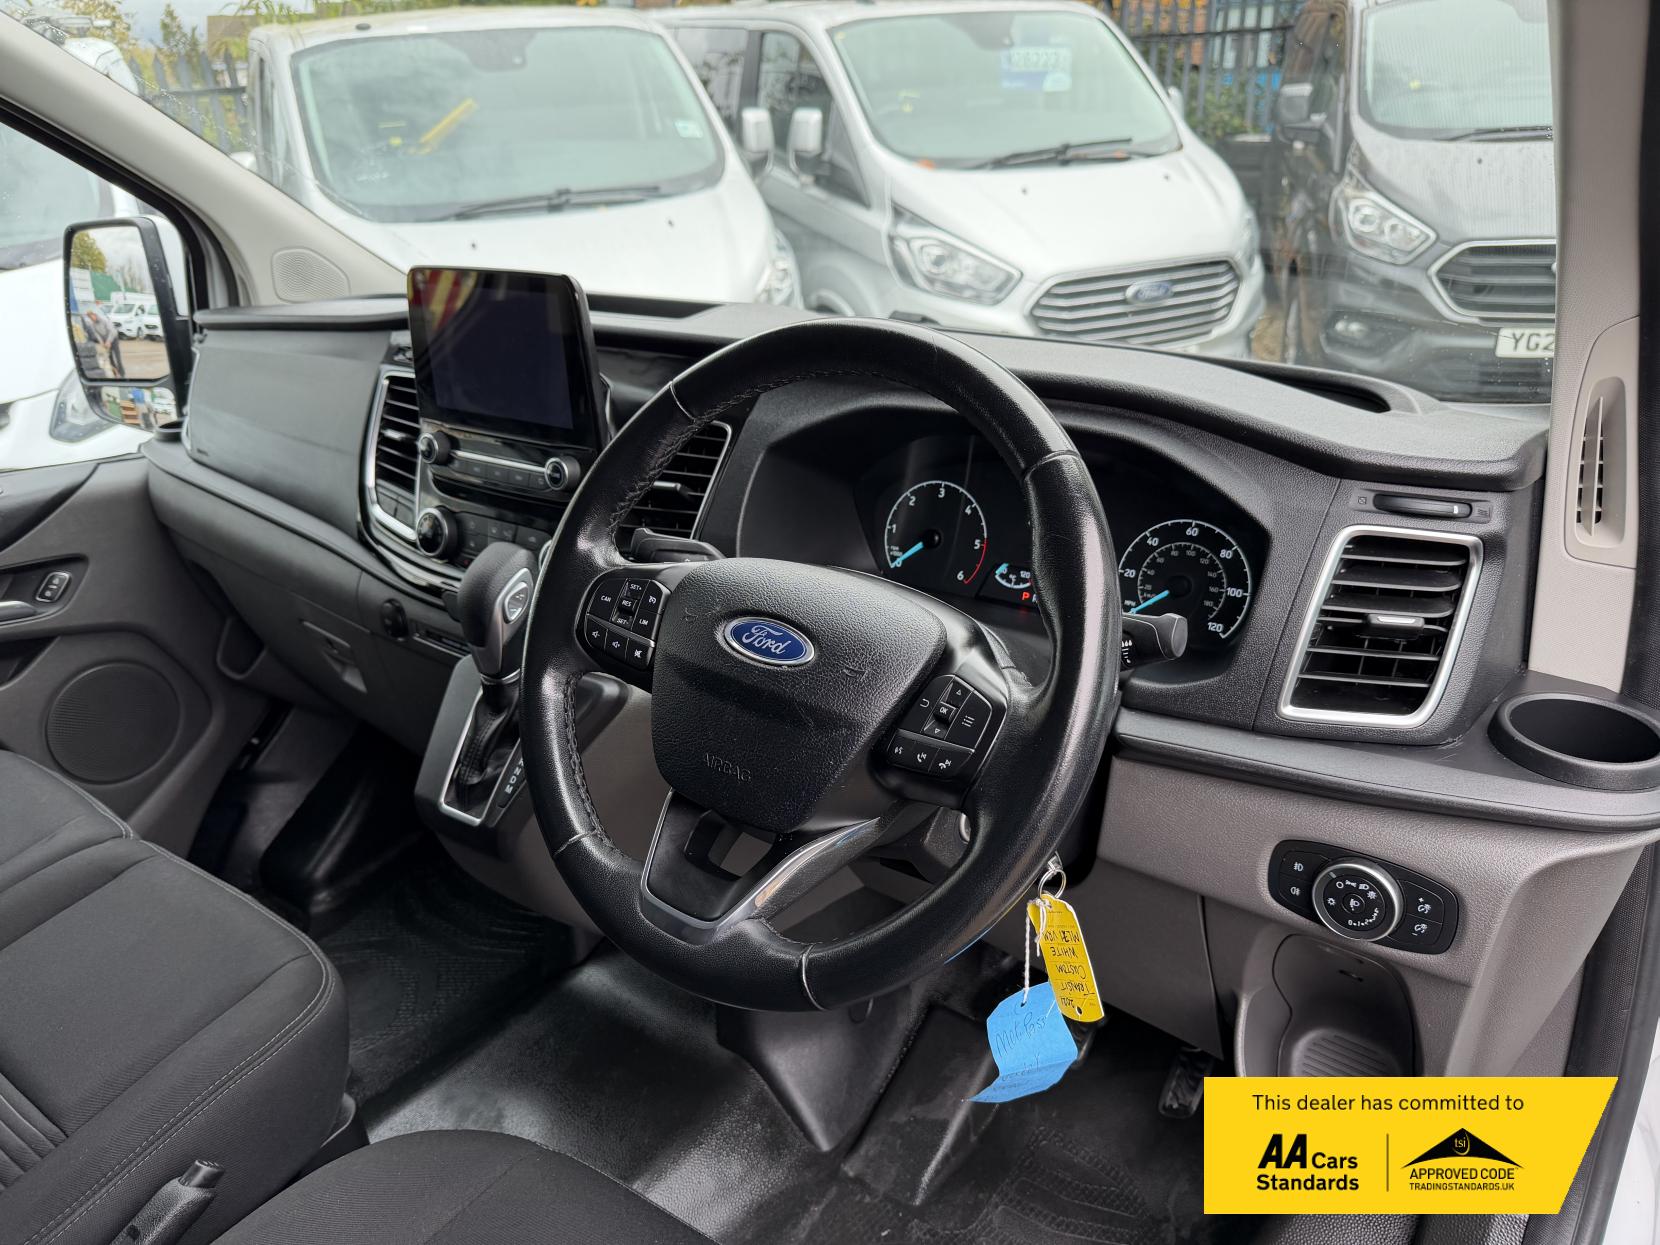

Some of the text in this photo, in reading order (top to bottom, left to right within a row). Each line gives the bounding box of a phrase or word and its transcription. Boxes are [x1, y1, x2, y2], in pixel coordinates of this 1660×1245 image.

[938, 488, 945, 498] 3
[909, 496, 916, 506] 2
[965, 505, 972, 515] 4
[892, 524, 897, 533] 1
[1186, 528, 1199, 537] 60
[974, 539, 981, 550] 5
[1146, 537, 1159, 546] 40
[1220, 549, 1233, 559] 80
[957, 570, 964, 581] 6
[1020, 570, 1031, 579] 120
[1124, 568, 1136, 578] 20
[1022, 591, 1031, 601] P
[1226, 587, 1243, 598] 100
[621, 599, 632, 607] RES
[1207, 621, 1224, 633] 120
[741, 624, 792, 655] Ford
[940, 706, 949, 715] OK
[1050, 946, 1079, 959] WHITE
